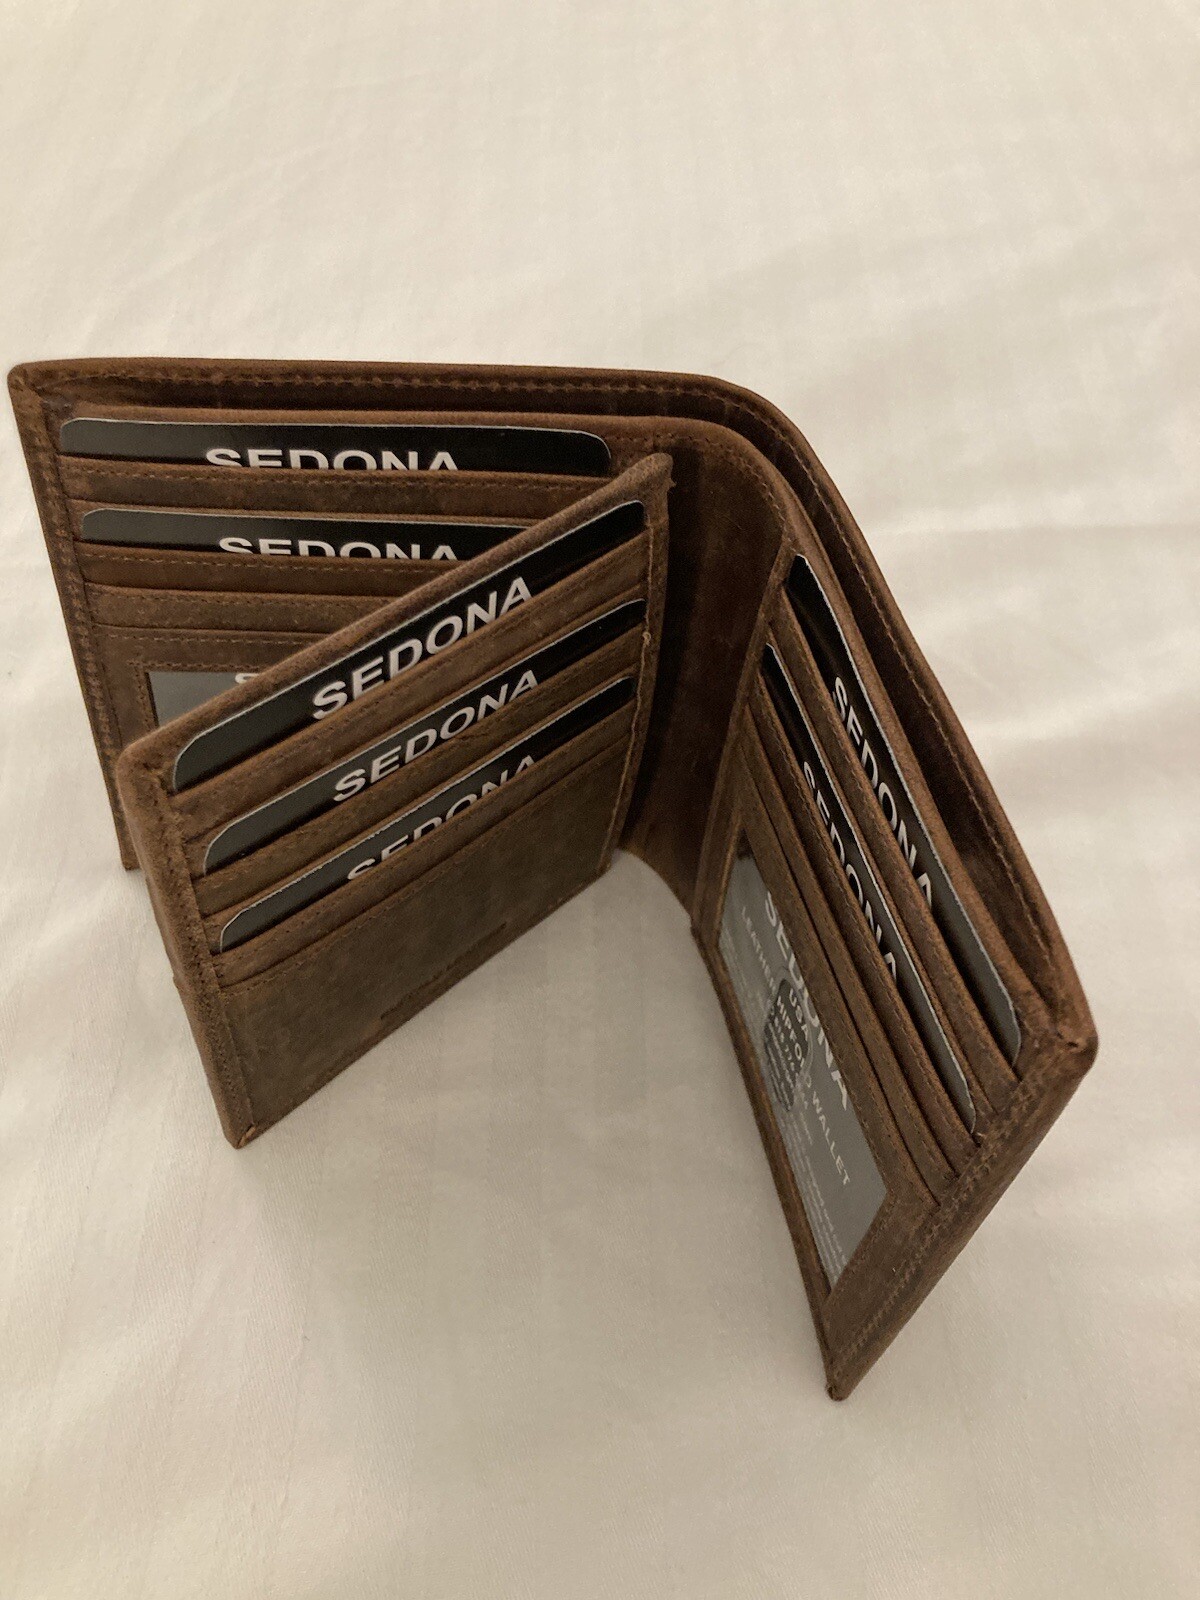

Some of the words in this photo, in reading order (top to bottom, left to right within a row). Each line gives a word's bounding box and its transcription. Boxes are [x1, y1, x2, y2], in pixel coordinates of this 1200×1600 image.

[206, 448, 458, 471] SEDONA
[219, 537, 458, 560] SEDONA
[312, 576, 532, 720] SEDONA
[334, 669, 539, 802] SEDONA
[833, 676, 932, 909] SEDONA
[347, 754, 536, 880] SEDONA
[812, 1090, 850, 1186] WALLET
